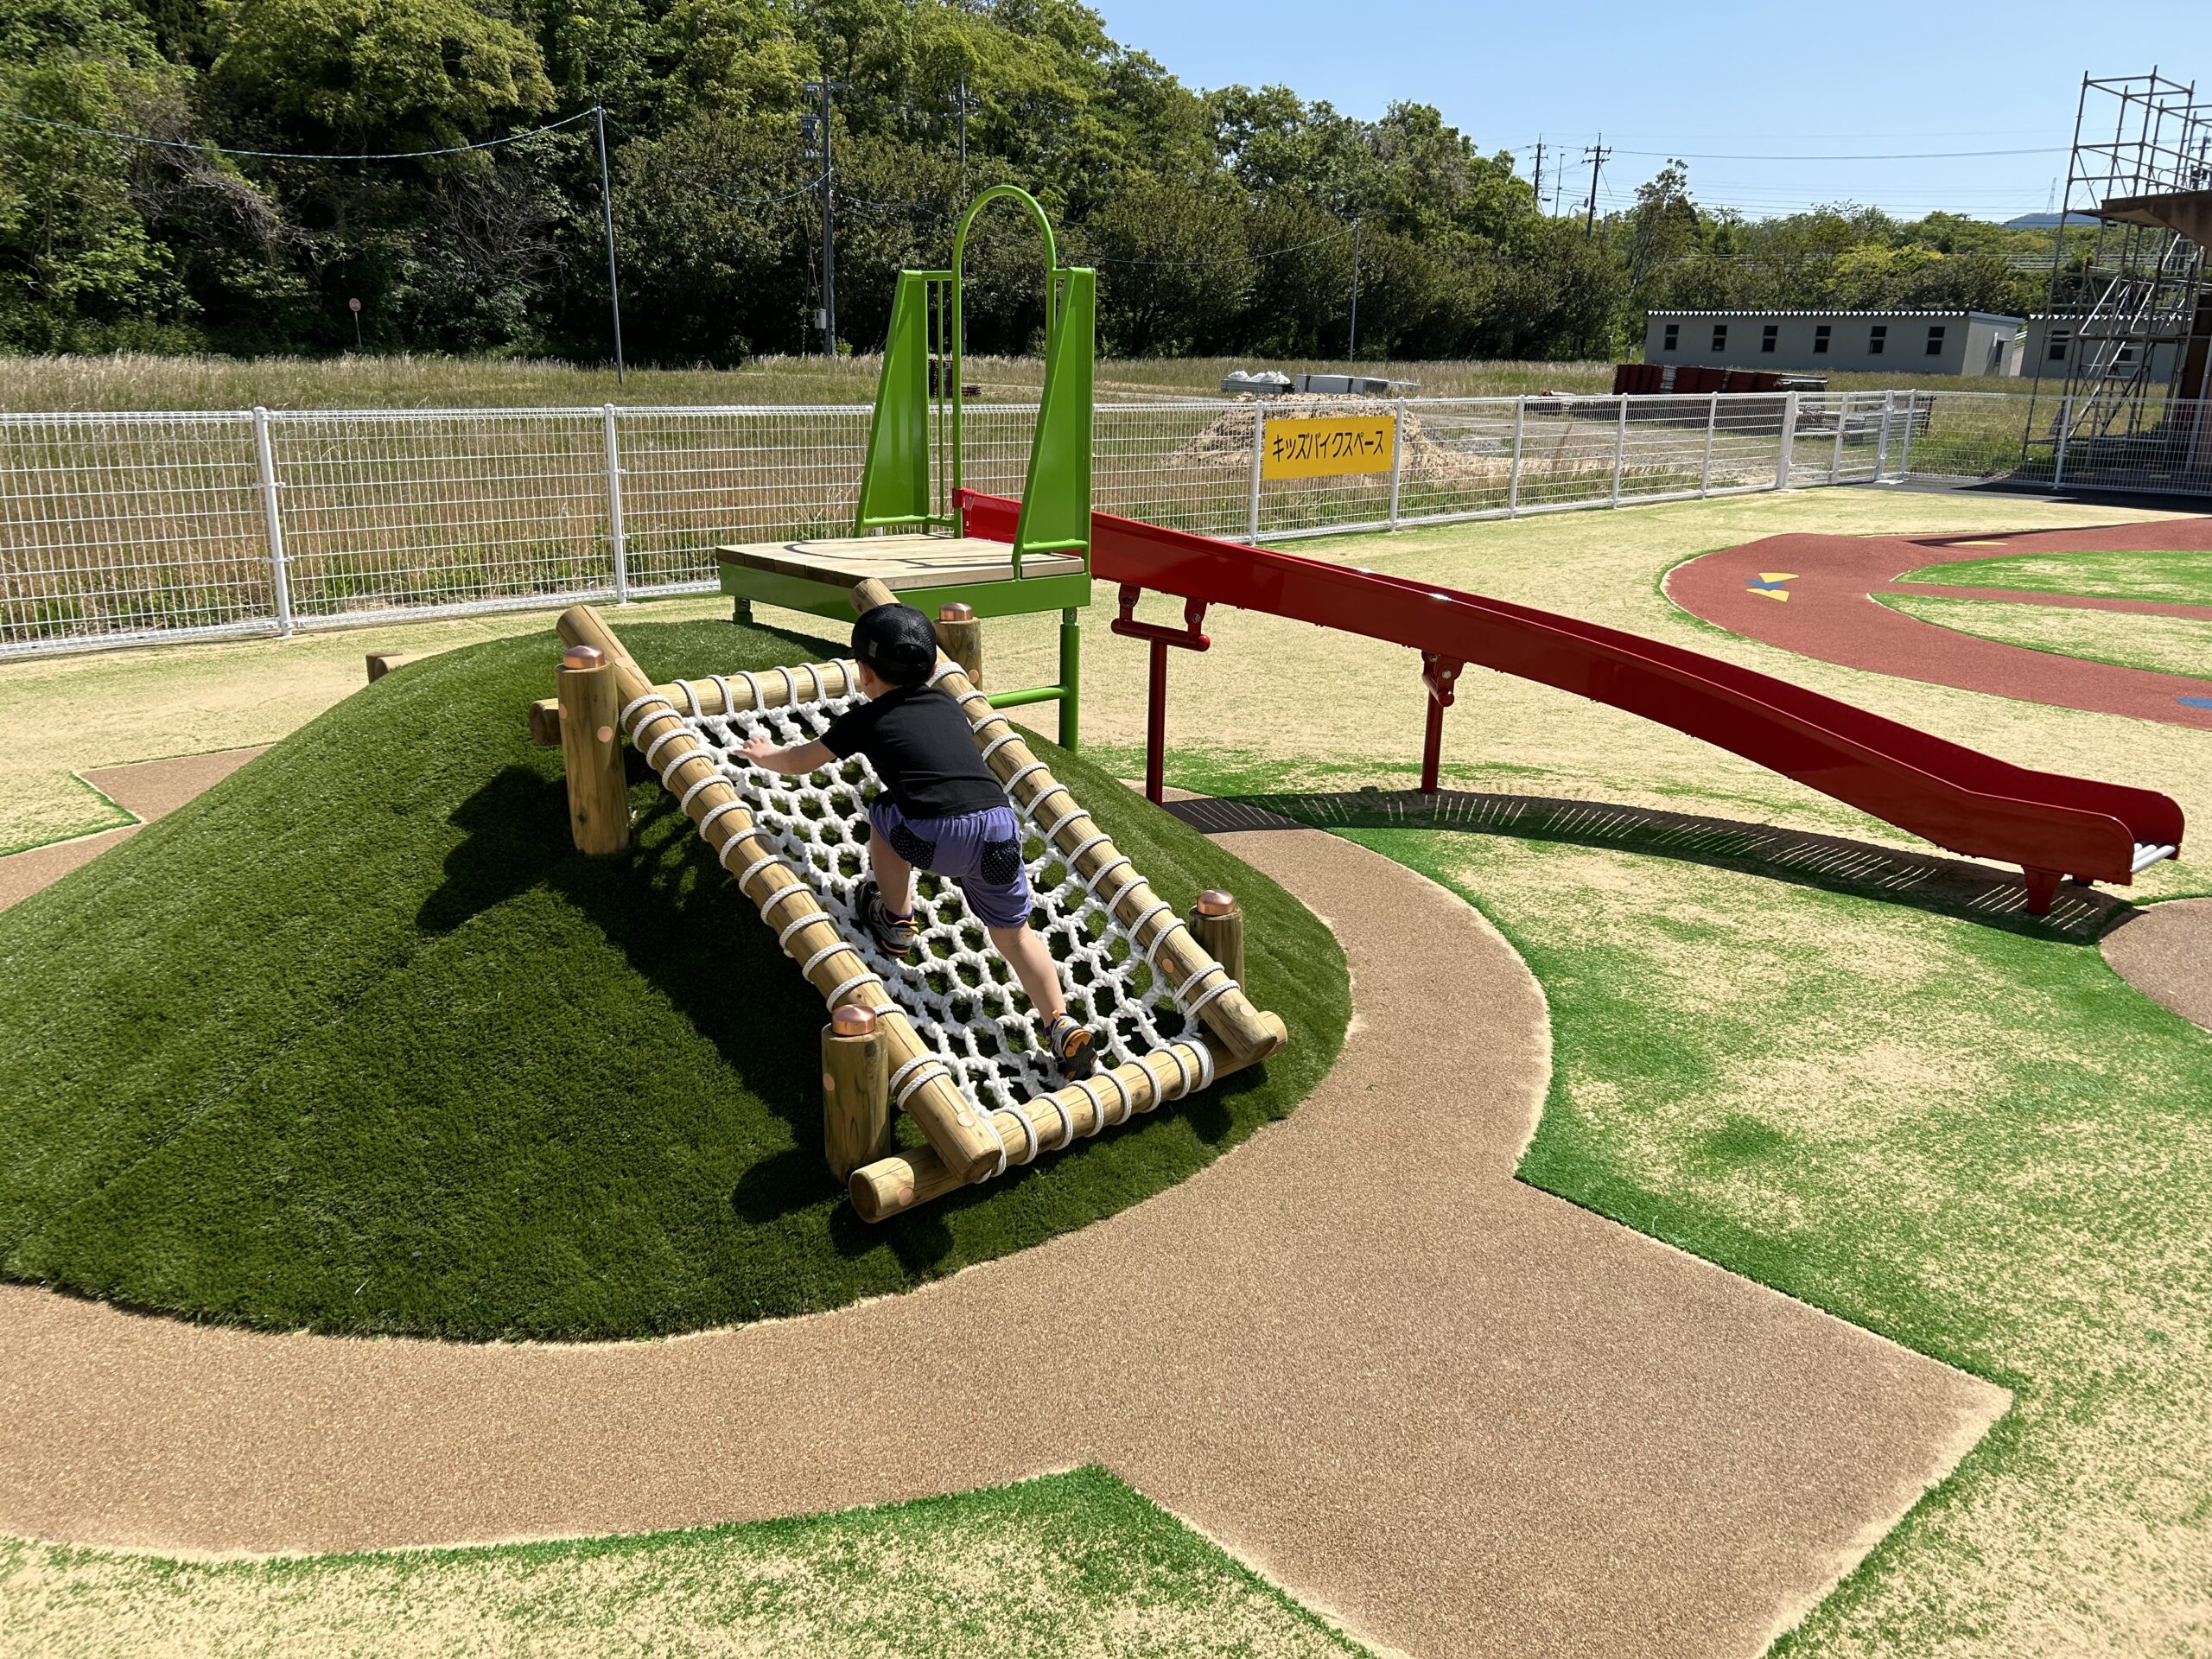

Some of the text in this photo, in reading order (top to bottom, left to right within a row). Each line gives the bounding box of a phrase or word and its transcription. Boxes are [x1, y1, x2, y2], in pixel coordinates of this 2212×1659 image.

[1273, 430, 1383, 462] キッズバイクスペース
